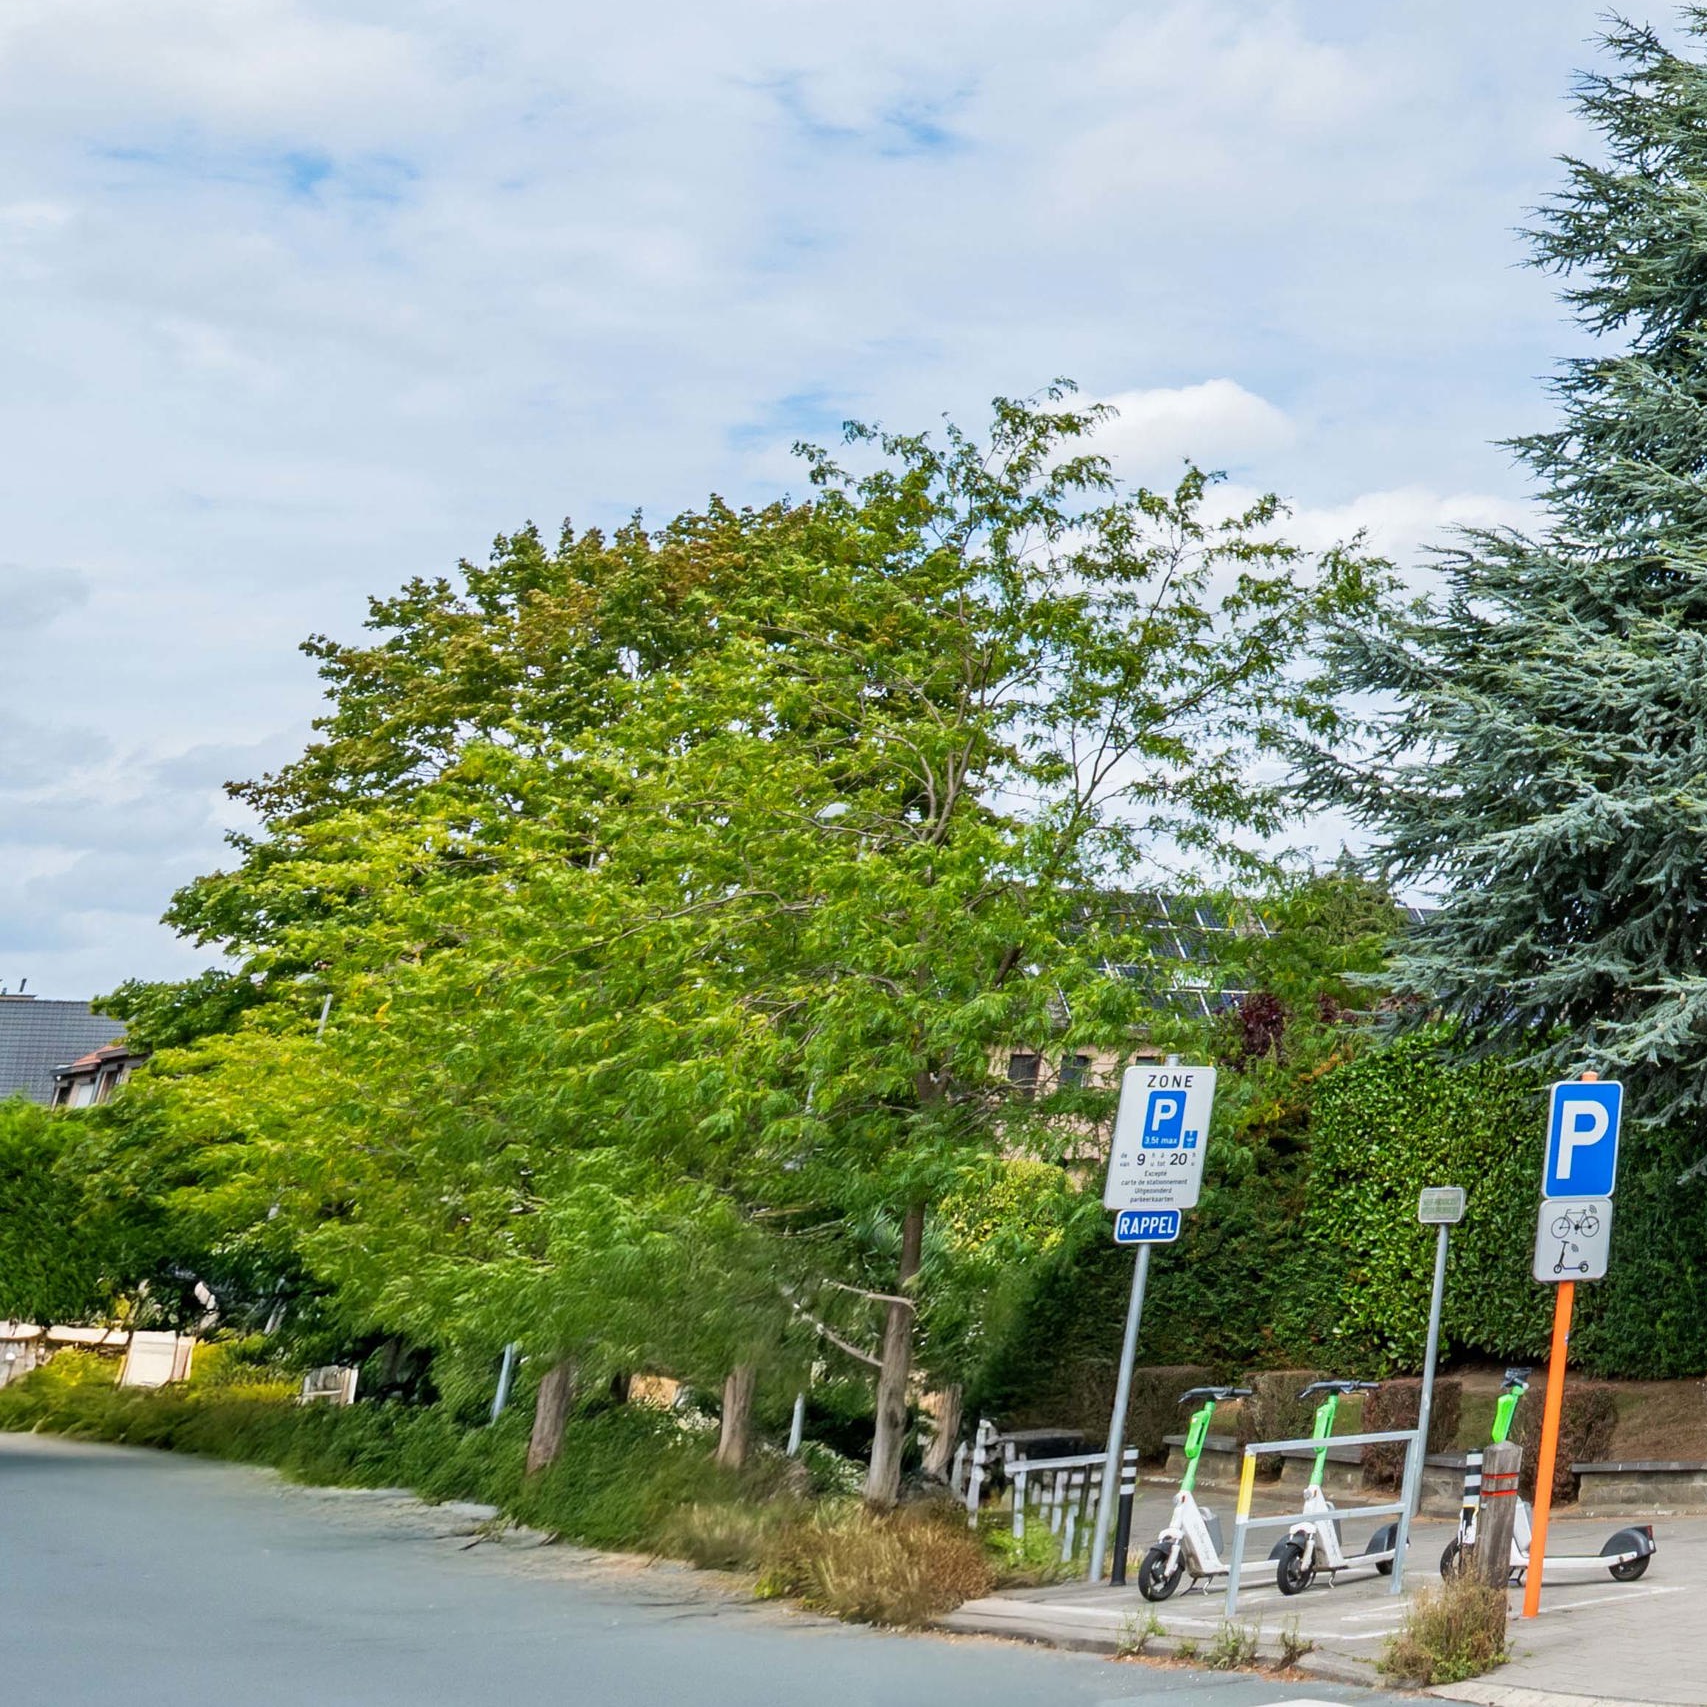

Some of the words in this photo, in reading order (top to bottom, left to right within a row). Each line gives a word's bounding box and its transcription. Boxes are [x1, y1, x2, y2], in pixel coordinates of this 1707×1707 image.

[1147, 1075, 1194, 1088] ZONE
[1152, 1098, 1178, 1132] P
[1556, 1100, 1610, 1180] P
[1137, 1152, 1146, 1166] 9
[1169, 1152, 1188, 1166] 20
[1134, 1187, 1172, 1195] Uitgezonderd
[1119, 1216, 1175, 1235] RAPPEL
